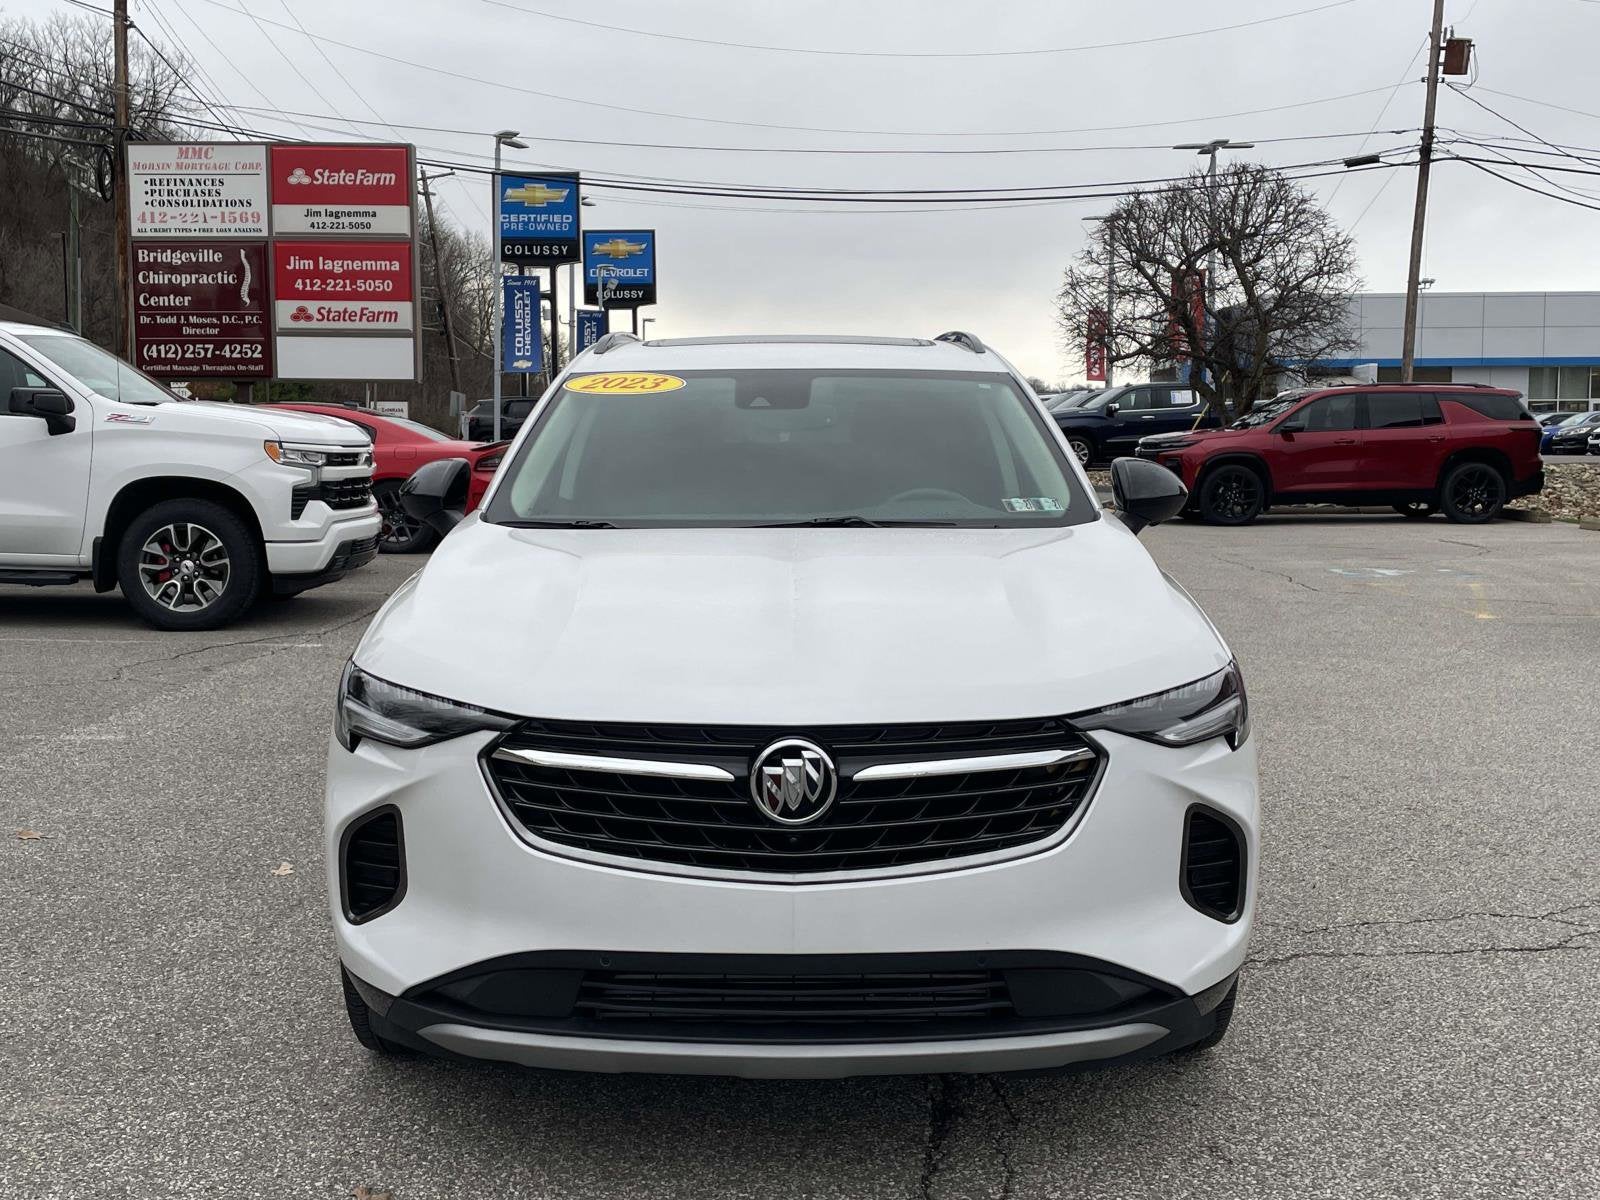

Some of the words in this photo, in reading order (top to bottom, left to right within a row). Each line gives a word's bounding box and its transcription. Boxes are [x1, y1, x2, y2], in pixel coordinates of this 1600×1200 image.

[176, 146, 215, 160] MMC
[175, 161, 231, 171] MORTGAGE
[149, 178, 225, 187] REFINANCES
[149, 188, 222, 198] PURCHASES
[150, 198, 252, 208] CONSOLIDATIONS
[137, 211, 261, 224] 412-221-1569
[304, 208, 322, 218] Jim
[324, 208, 377, 220] Iagnemma
[501, 214, 573, 223] CERTIFIED
[309, 221, 372, 230] 412-221-5050
[503, 222, 569, 231] PRE-OWNED
[504, 245, 569, 255] COLUSSY
[137, 249, 223, 266] Bridgeville
[286, 256, 314, 270] Jim
[318, 256, 400, 274] Iagnemma
[589, 268, 649, 277] CHEVROLET
[137, 270, 238, 287] Chiropractic
[294, 278, 393, 292] 412-221-5050
[138, 293, 192, 307] Center
[139, 315, 154, 324] Dr.
[156, 315, 177, 324] Todd
[179, 315, 187, 325] J.
[188, 315, 220, 325] Moses,
[244, 315, 263, 324] P.C.
[514, 290, 524, 356] COLUSSY
[523, 290, 531, 356] CHEVROLET
[182, 326, 220, 335] Director
[142, 343, 183, 361] (412)
[184, 343, 263, 359] 257-4252
[172, 364, 200, 372] Massage
[201, 364, 236, 372] Therapists
[580, 376, 669, 389] 2023
